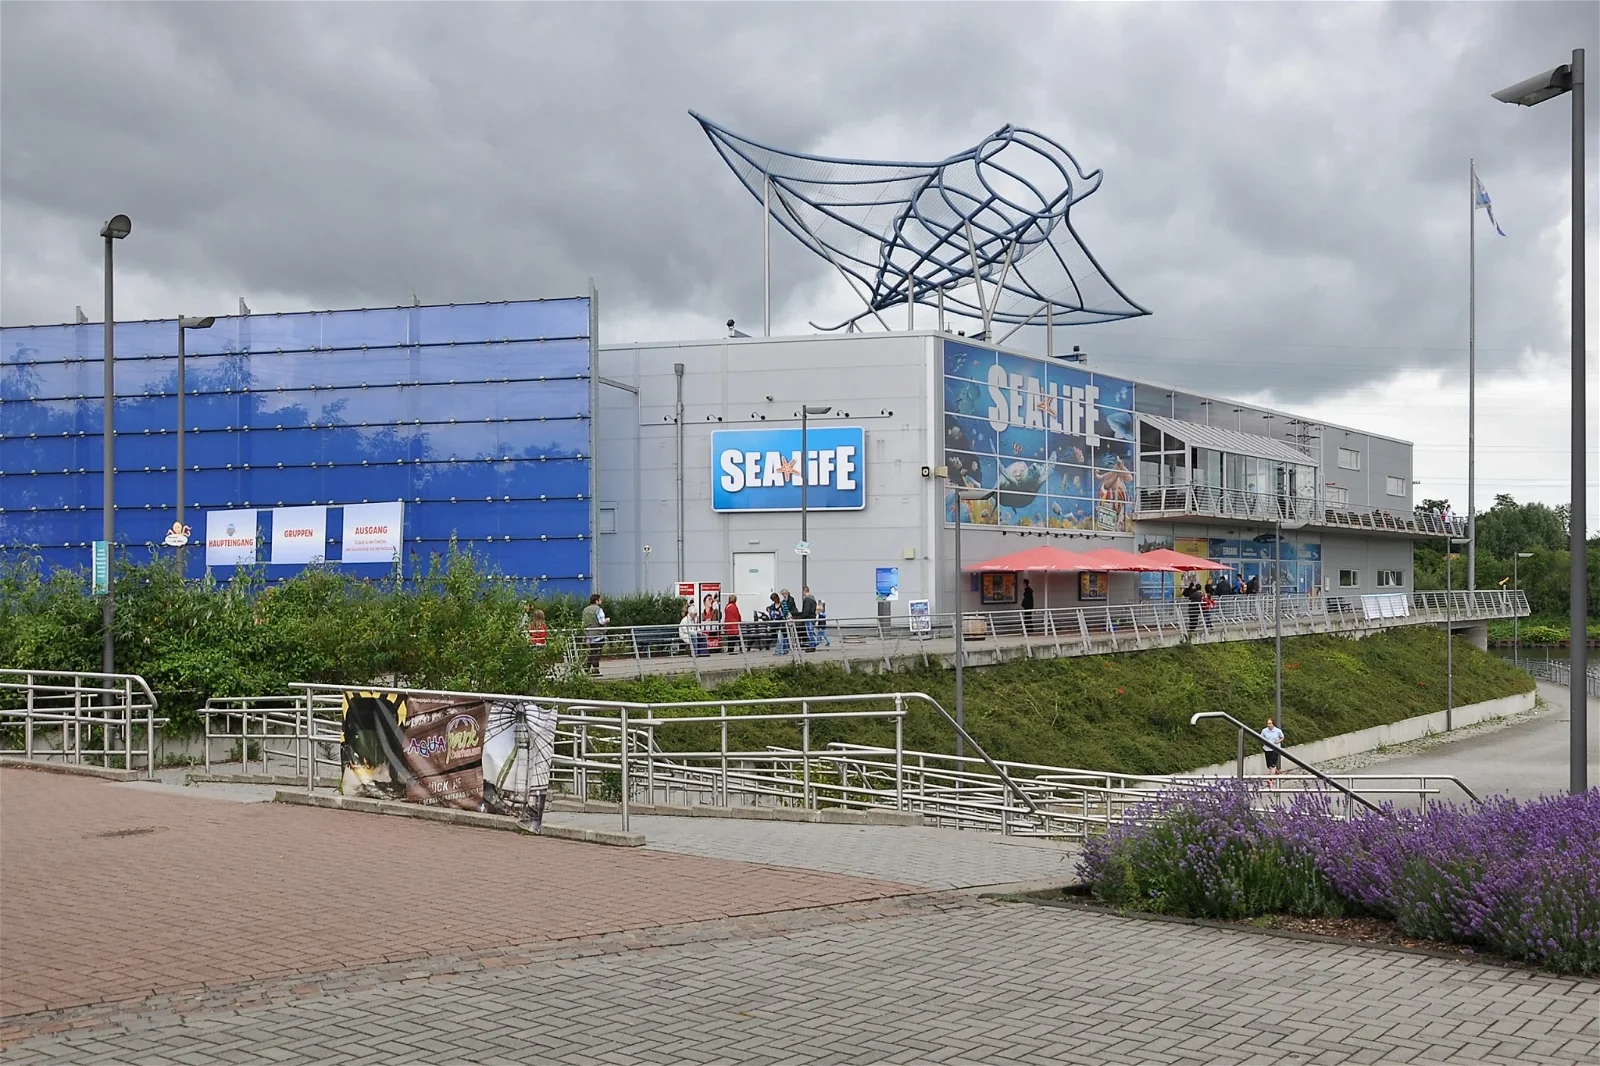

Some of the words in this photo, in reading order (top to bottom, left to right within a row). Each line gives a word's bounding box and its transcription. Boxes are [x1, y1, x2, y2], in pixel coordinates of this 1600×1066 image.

[987, 364, 1045, 432] SEA
[720, 448, 785, 493] SEA
[284, 529, 314, 539] GRUPPEN
[354, 526, 388, 536] AUSGANG
[208, 538, 254, 548] HAUPTEINGANG
[408, 735, 447, 758] AQUA
